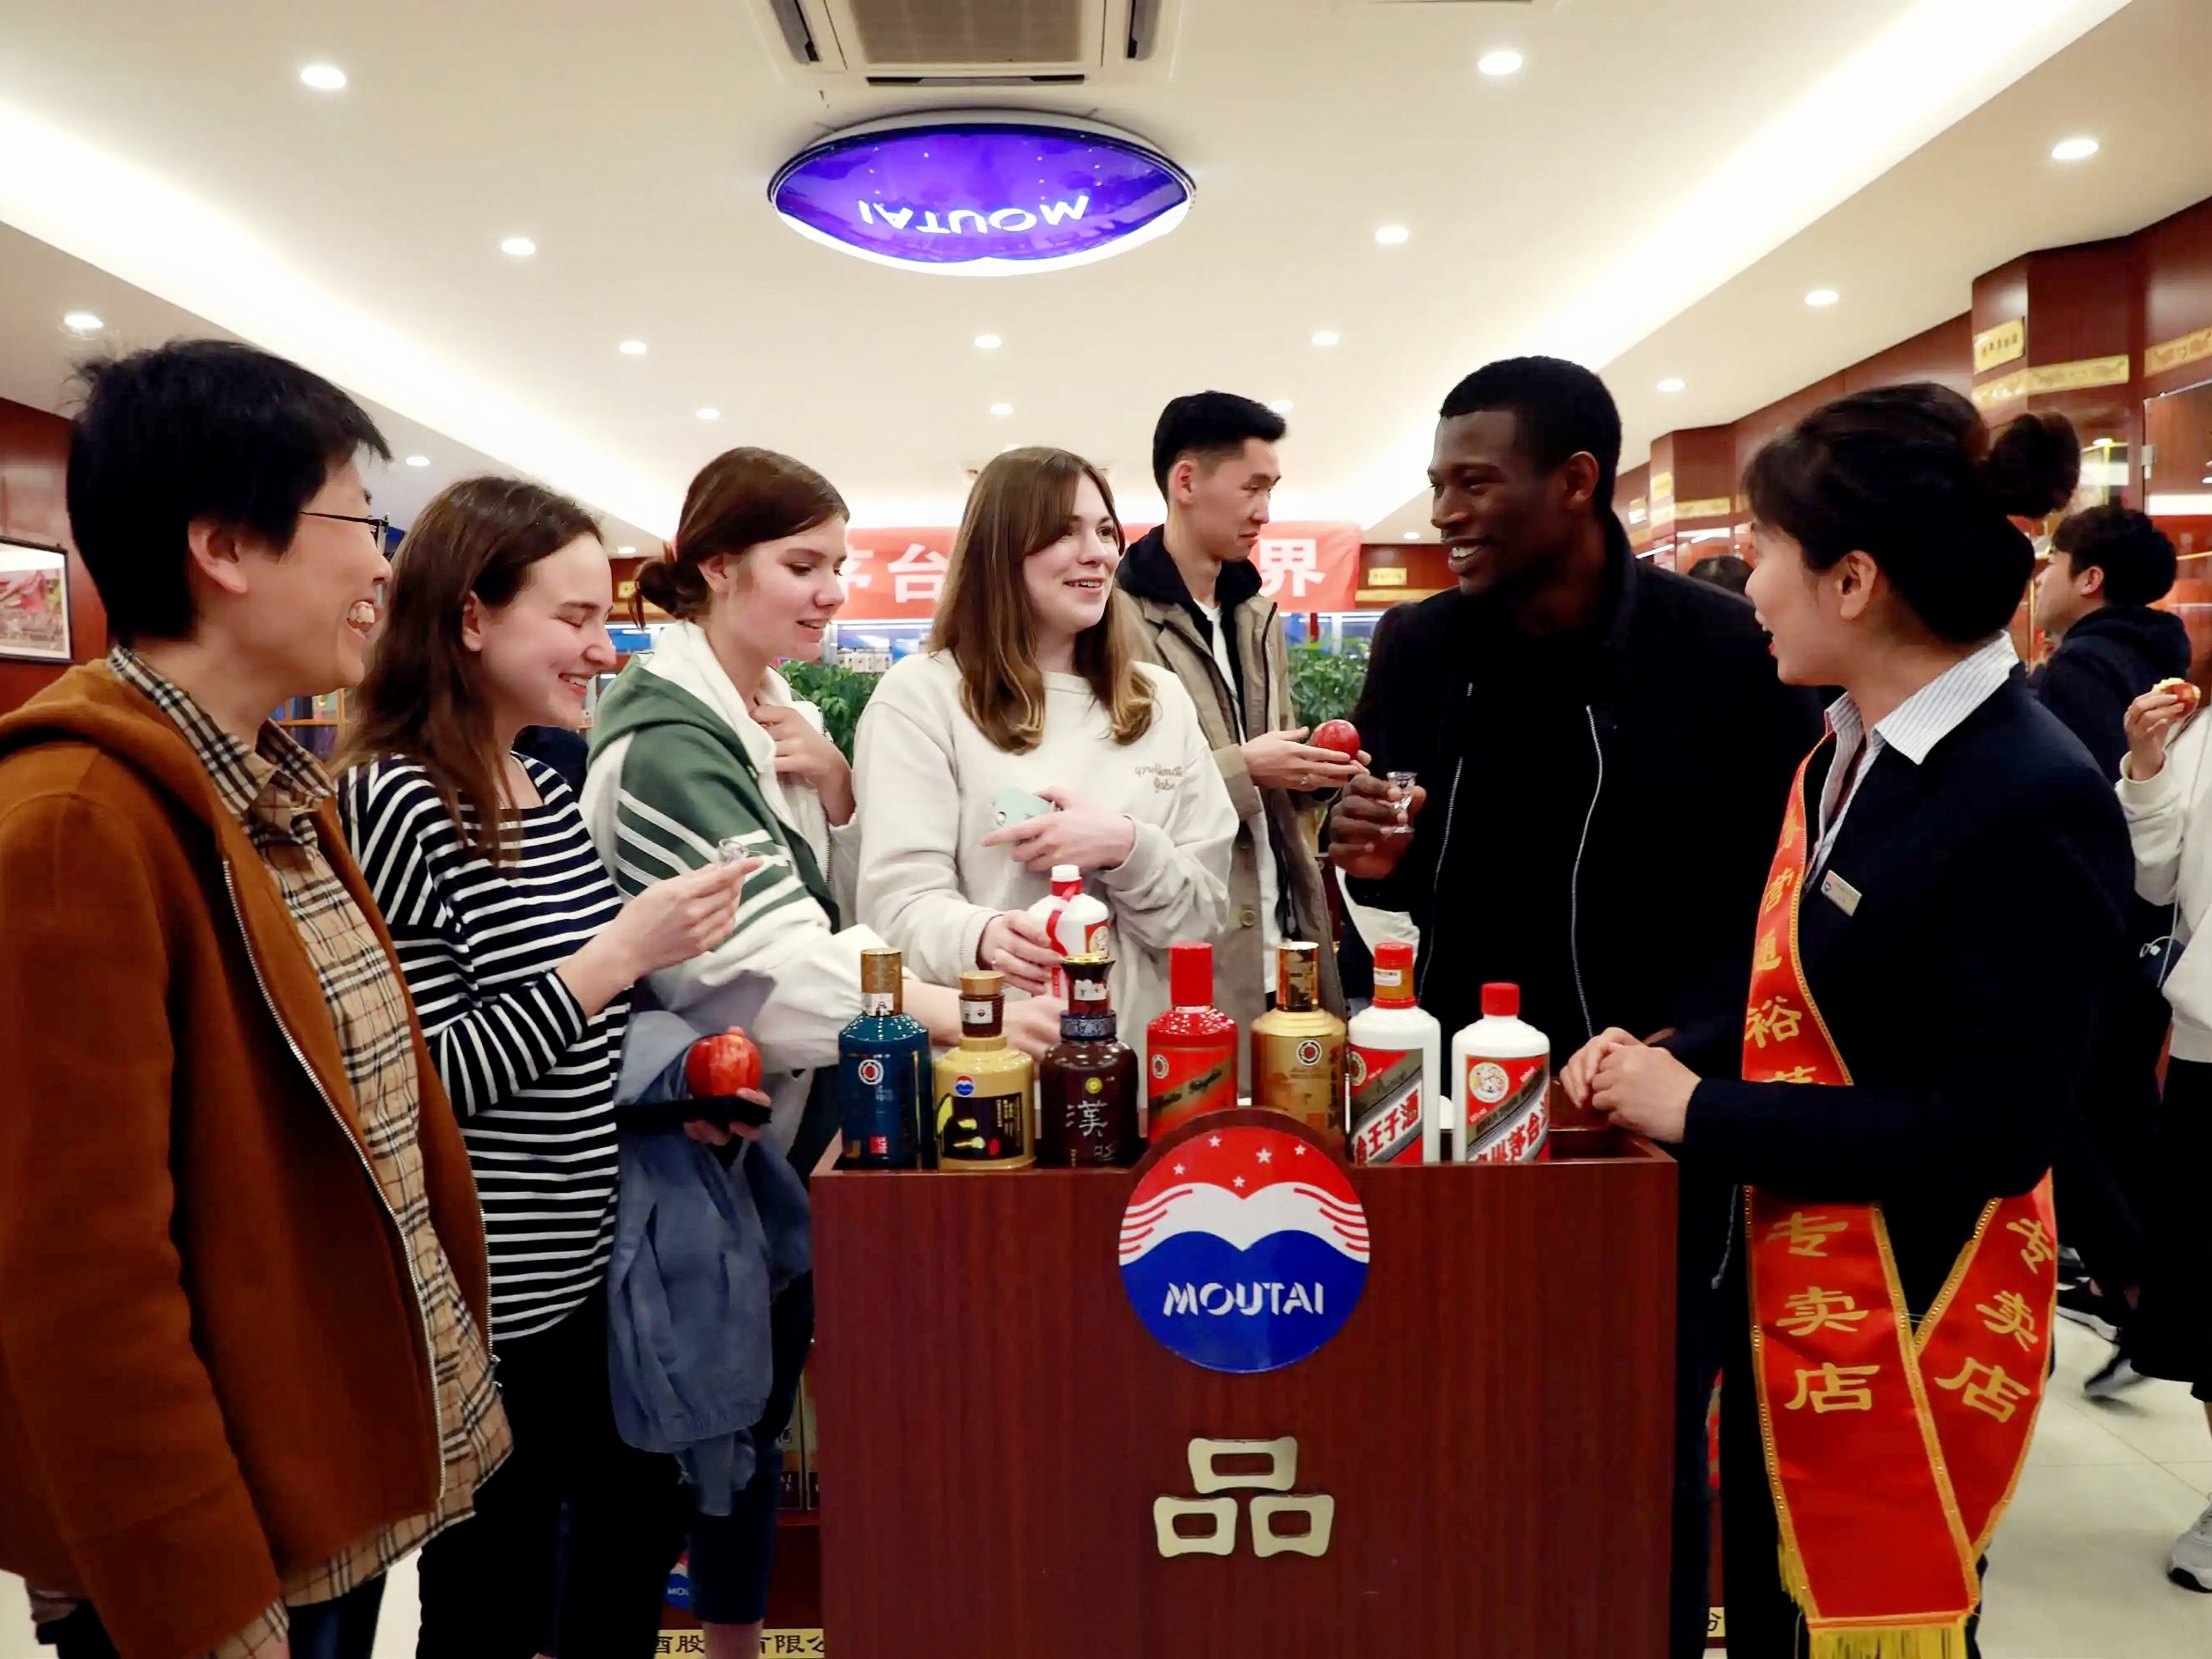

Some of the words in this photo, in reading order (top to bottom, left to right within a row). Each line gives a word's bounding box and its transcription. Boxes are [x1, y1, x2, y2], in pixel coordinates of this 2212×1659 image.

[857, 195, 1089, 234] MOUTAI
[1259, 539, 1326, 598] 界
[1066, 1099, 1108, 1137] 漢
[1163, 1282, 1324, 1316] MOUTAI
[1765, 1212, 1881, 1413] 专卖店
[1934, 1218, 2056, 1424] 专卖店
[1153, 1437, 1334, 1558] 品
